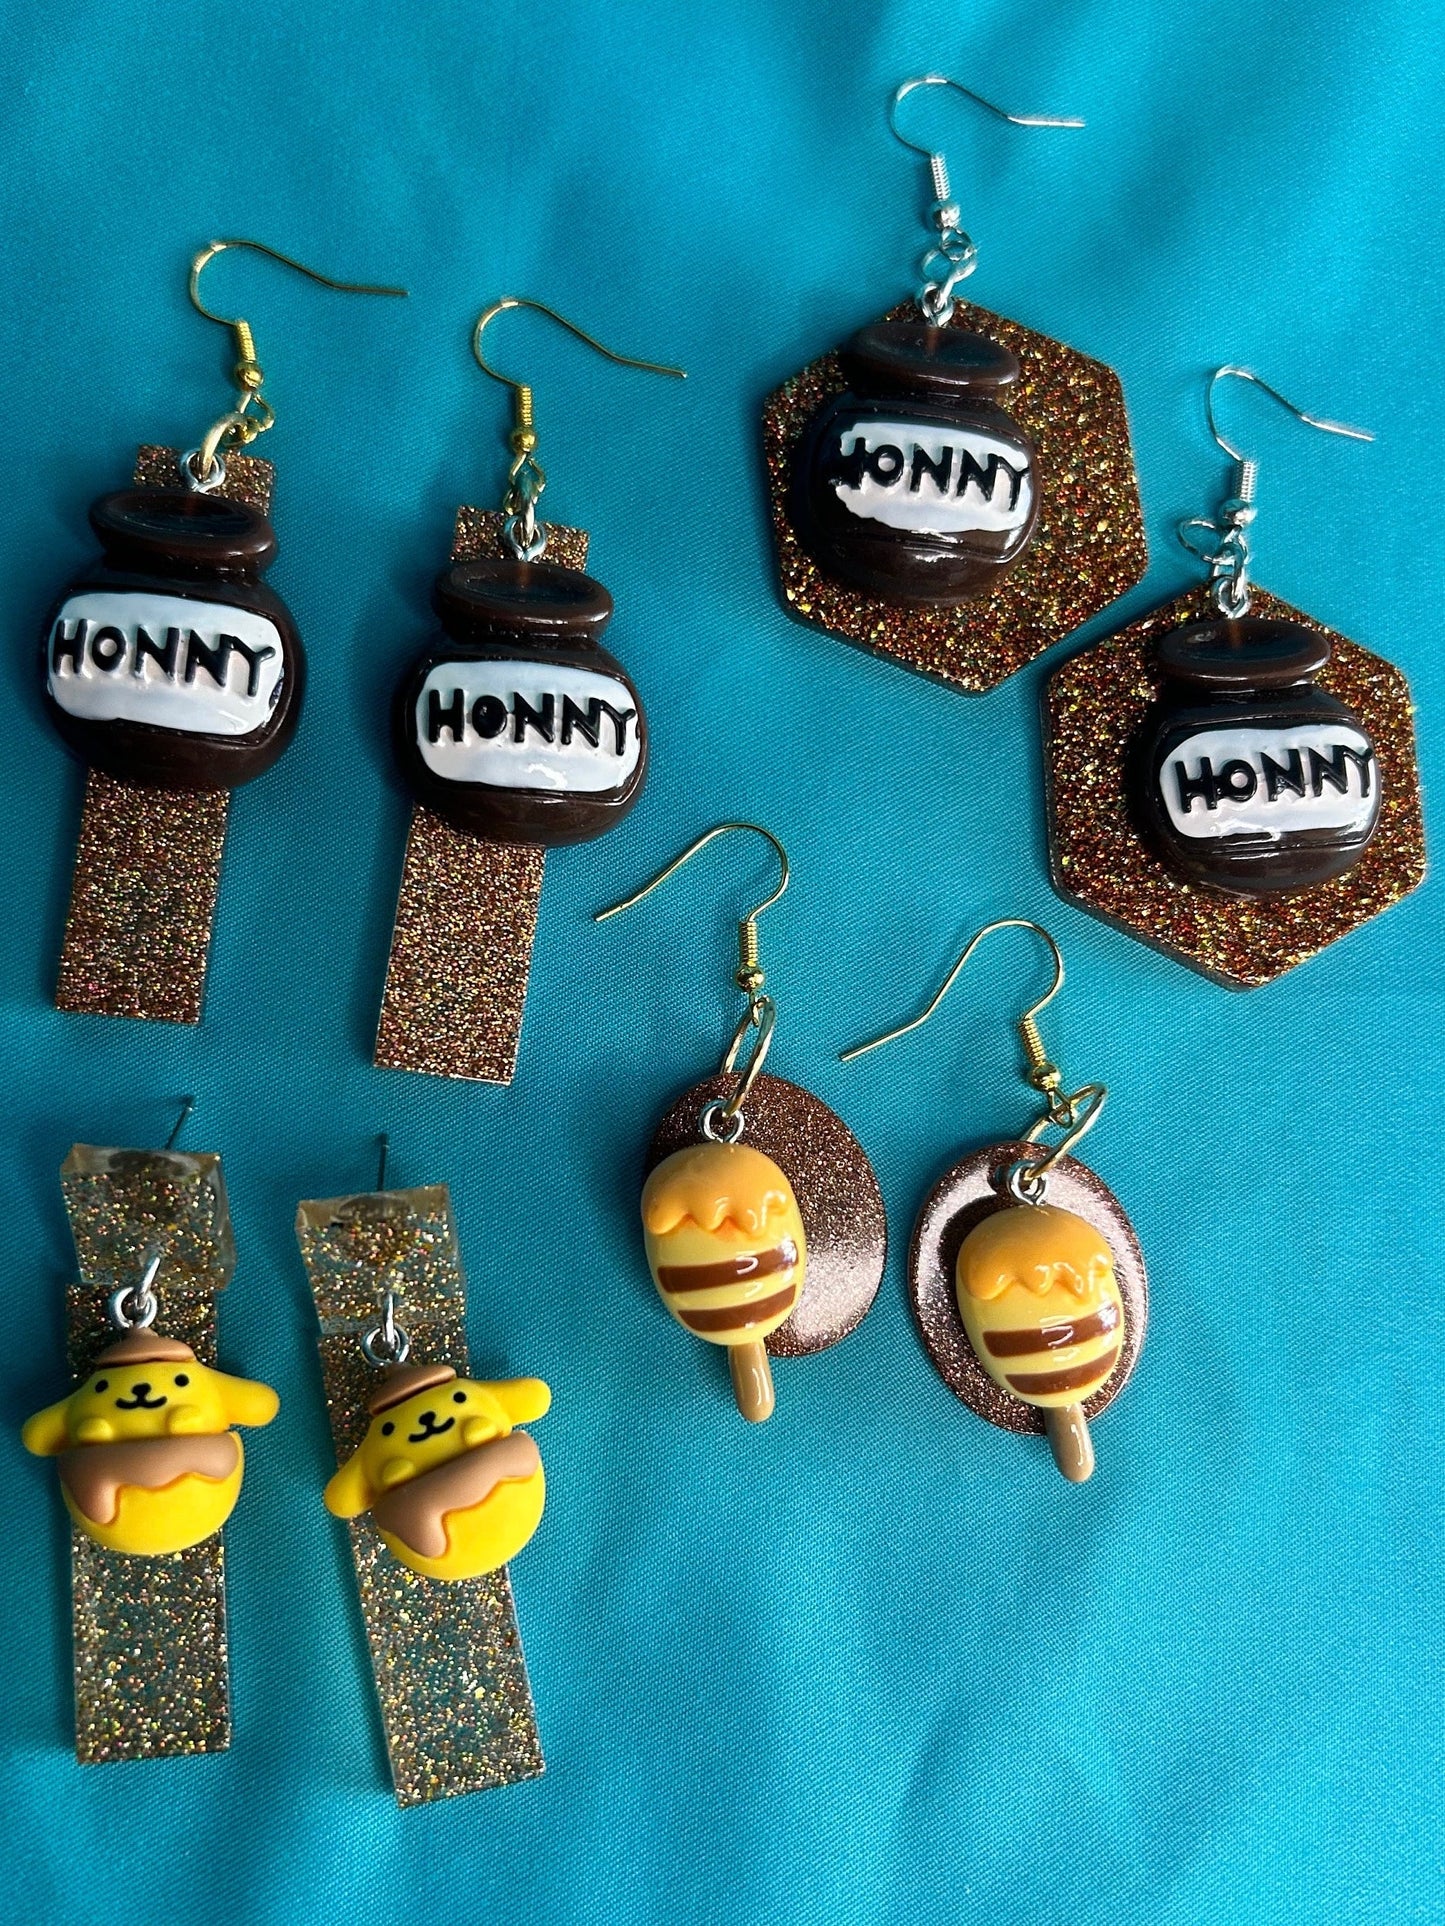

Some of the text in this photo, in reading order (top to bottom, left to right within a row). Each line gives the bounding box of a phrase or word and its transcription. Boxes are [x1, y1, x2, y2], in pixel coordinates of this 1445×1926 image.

[53, 618, 276, 697] HONNY
[428, 688, 637, 756] HONNY
[1175, 745, 1373, 814] HONNY
